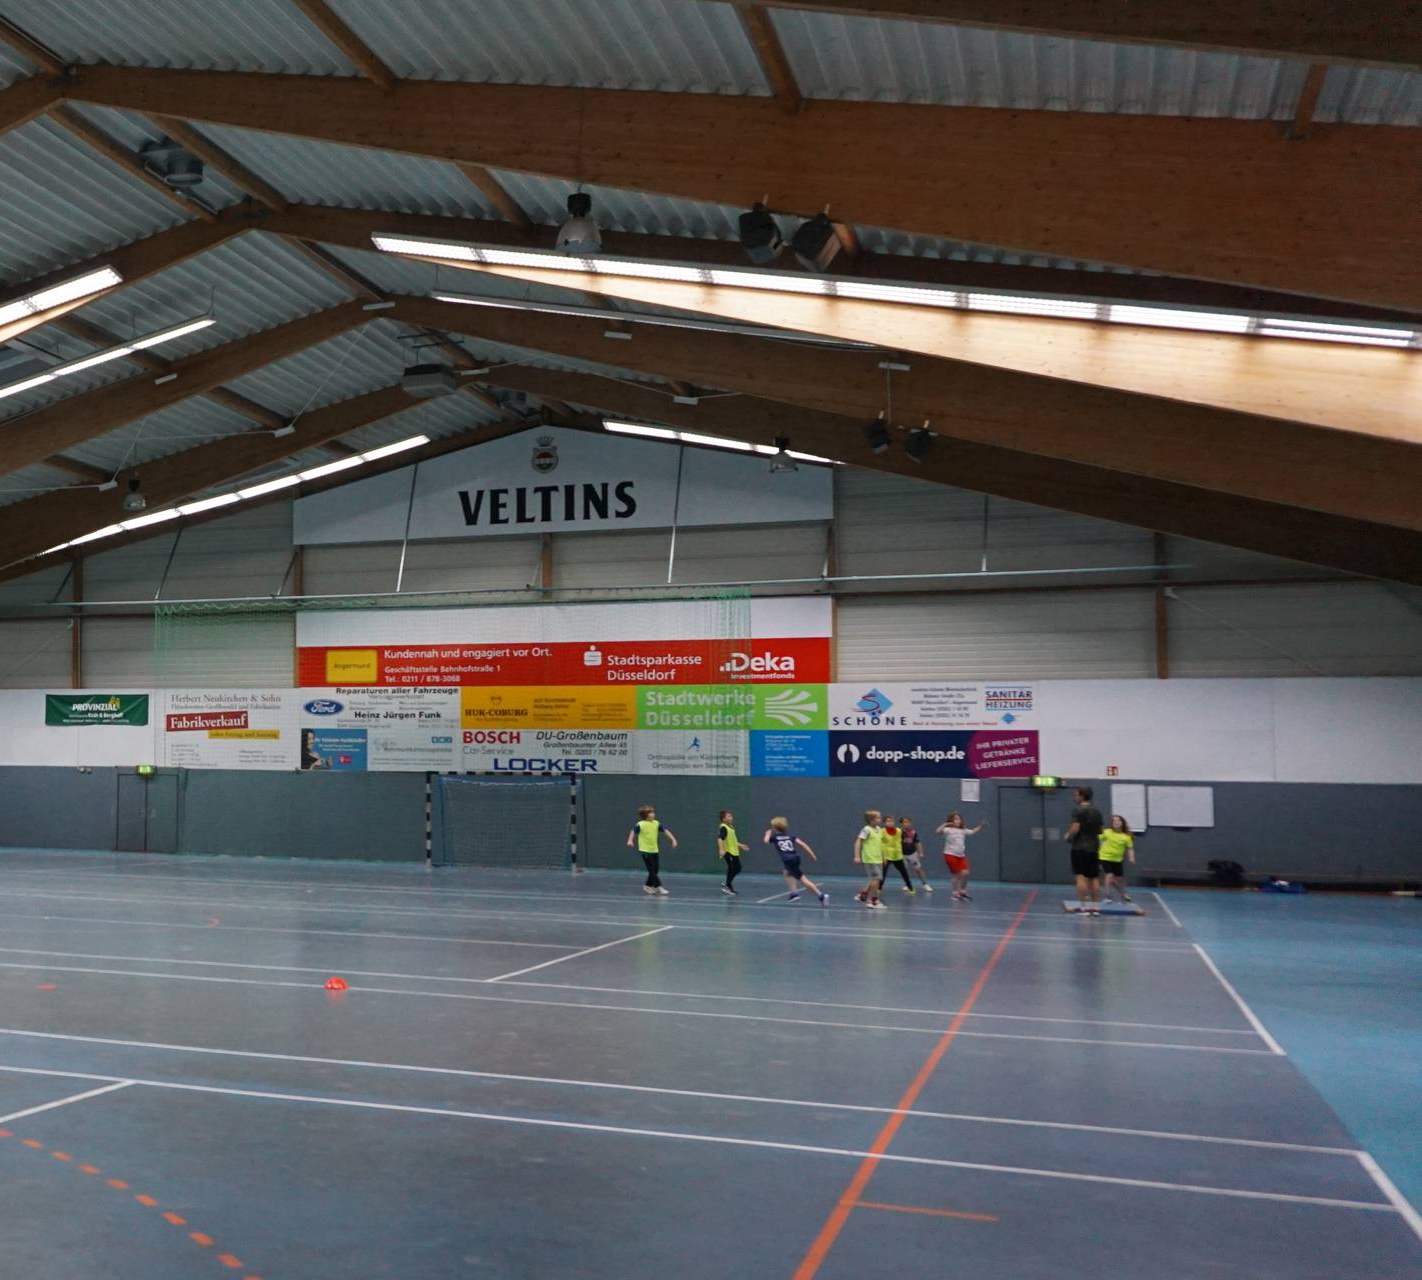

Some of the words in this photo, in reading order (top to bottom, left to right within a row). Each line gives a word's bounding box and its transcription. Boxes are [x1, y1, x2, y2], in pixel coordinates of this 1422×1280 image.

[458, 481, 637, 526] VELTINS
[384, 649, 440, 658] Kundennah
[442, 649, 459, 658] und
[462, 648, 510, 660] engagiert
[512, 650, 527, 658] vor
[531, 648, 552, 657] Ort.
[607, 653, 702, 668] Stadtsparkasse
[730, 652, 794, 671] Deka
[385, 665, 438, 673] Geschäftsstelle
[440, 664, 494, 673] Bahnhofstraße
[607, 668, 676, 681] Düsseldorf
[336, 687, 389, 695] Reparaturen
[391, 687, 410, 695] aller
[413, 687, 459, 695] Fahrzeuge
[171, 694, 201, 702] Herbert
[203, 694, 247, 702] Neukirchen
[250, 694, 257, 702] &
[261, 694, 281, 702] Sohn
[646, 690, 755, 705] Stadtwerke
[72, 703, 118, 711] PROVINZIAL
[311, 701, 337, 713] Ford
[986, 701, 1033, 709] HEIZUNG
[354, 711, 380, 719] Heinz
[383, 711, 416, 720] Jürgen
[419, 711, 442, 719] Funk
[465, 708, 529, 717] HUK-COBURG
[646, 710, 755, 725] Düsseldorf
[171, 713, 247, 729] Fabrikverkauf
[463, 731, 521, 744] BOSCH
[536, 731, 628, 741] DU-Großenbaum
[992, 737, 1029, 748] PRIVATER
[866, 745, 966, 763] dopp-shop.de
[493, 758, 598, 772] LOCKER
[975, 757, 1036, 769] LIEFERSERVICE
